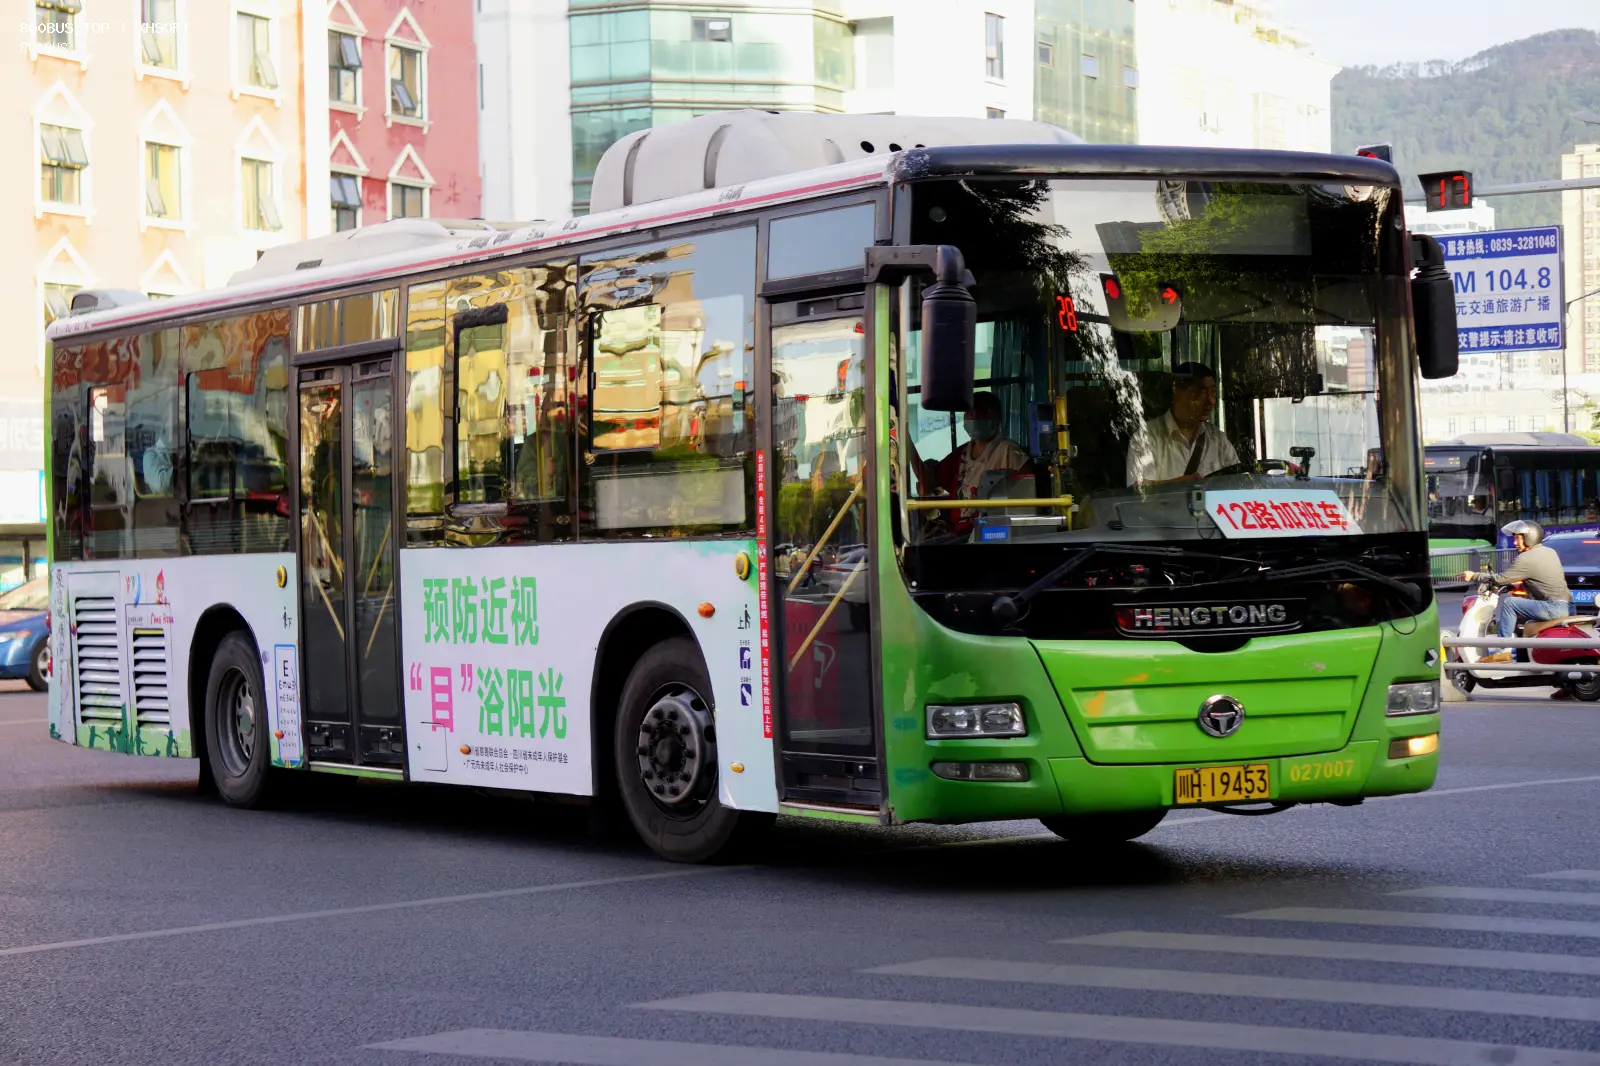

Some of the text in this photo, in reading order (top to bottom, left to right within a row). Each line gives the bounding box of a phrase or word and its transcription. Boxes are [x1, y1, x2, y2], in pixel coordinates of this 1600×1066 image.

[1438, 175, 1469, 207] 17
[1449, 266, 1551, 294] M 104.8
[1216, 500, 1350, 531] 12路加班车
[422, 575, 540, 647] 预防近视
[1134, 604, 1287, 627] HENGTONG
[1290, 760, 1355, 782] 027007
